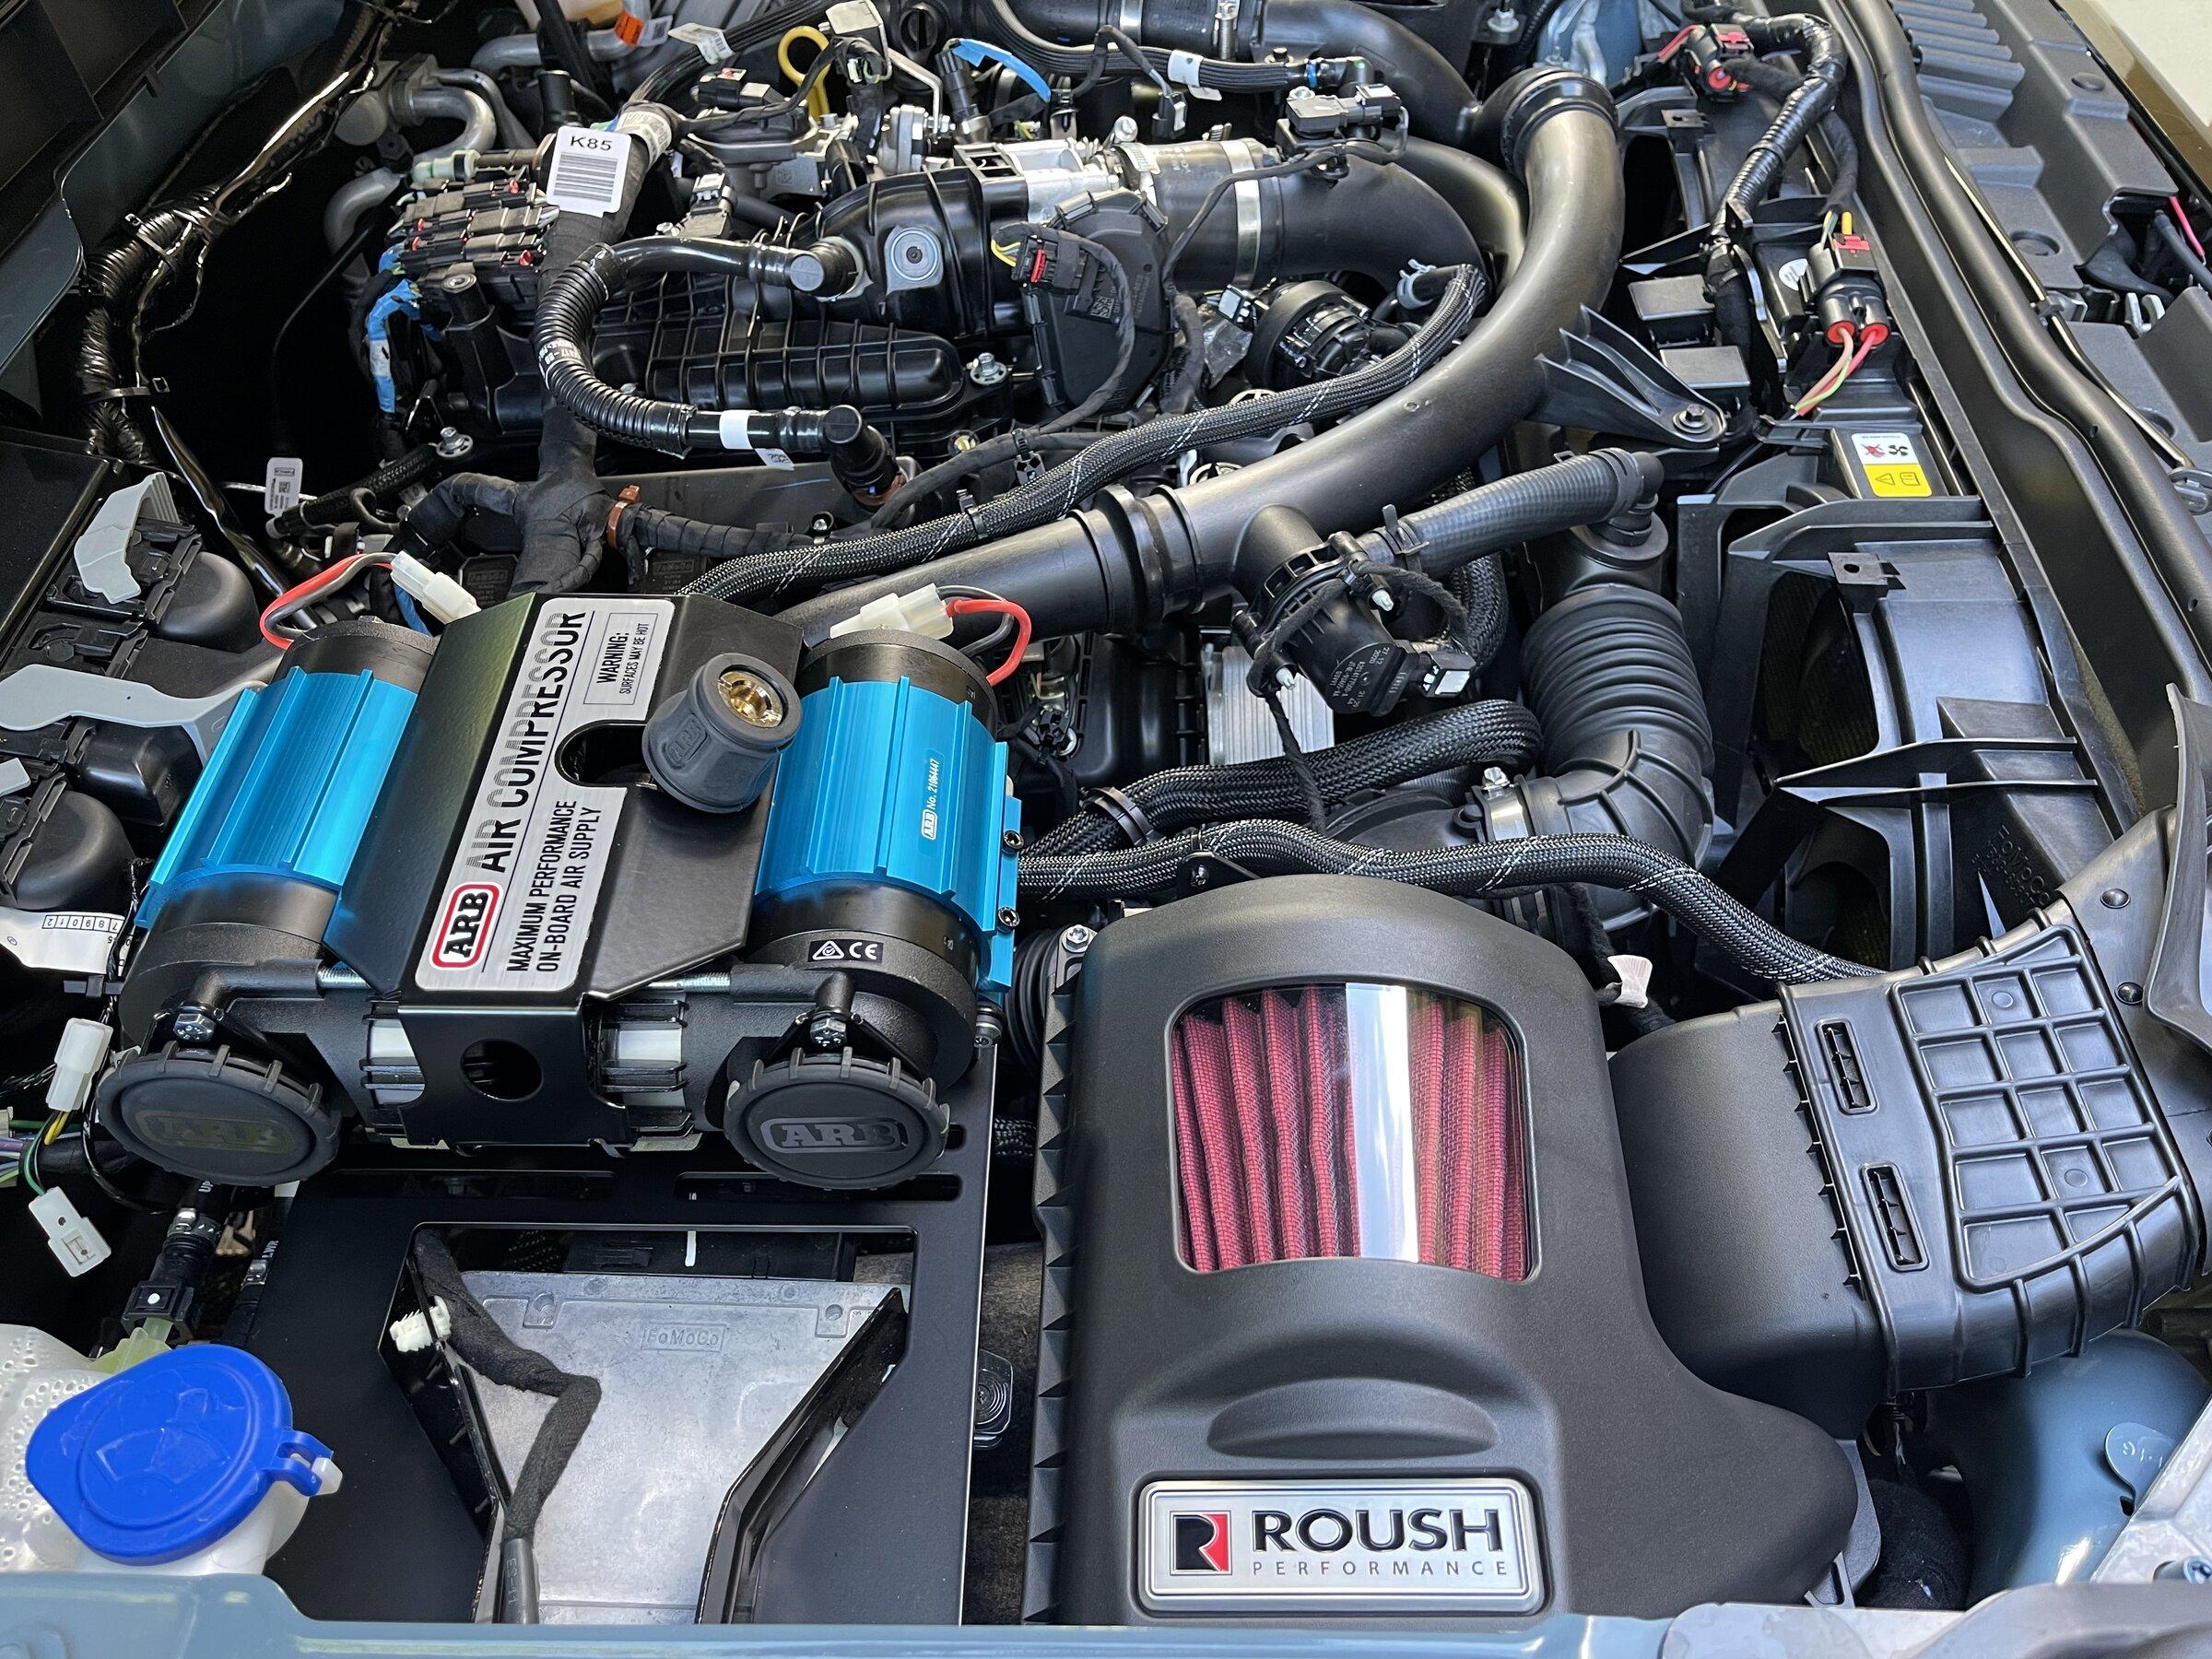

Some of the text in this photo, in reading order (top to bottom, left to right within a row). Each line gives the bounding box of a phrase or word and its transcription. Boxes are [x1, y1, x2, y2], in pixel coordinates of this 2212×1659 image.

[570, 135, 613, 151] K85
[597, 632, 629, 684] WARNING:
[619, 623, 650, 694] SURFACES MAY BE HOT
[487, 612, 586, 808] COMPRESSOR
[923, 810, 936, 839] ARB
[926, 794, 937, 810] No.
[465, 819, 522, 874] AIR
[507, 800, 577, 971] MAXIMUM PERFORMANCE
[536, 807, 602, 972] ON-BOARD AIR SUPPLY
[443, 891, 488, 959] ARB
[849, 941, 878, 960] CE
[782, 1124, 898, 1147] ARB
[647, 1328, 719, 1346] FoMoCo
[1252, 1508, 1505, 1553] ROUSH
[1253, 1560, 1507, 1576] PERFORMANCE
